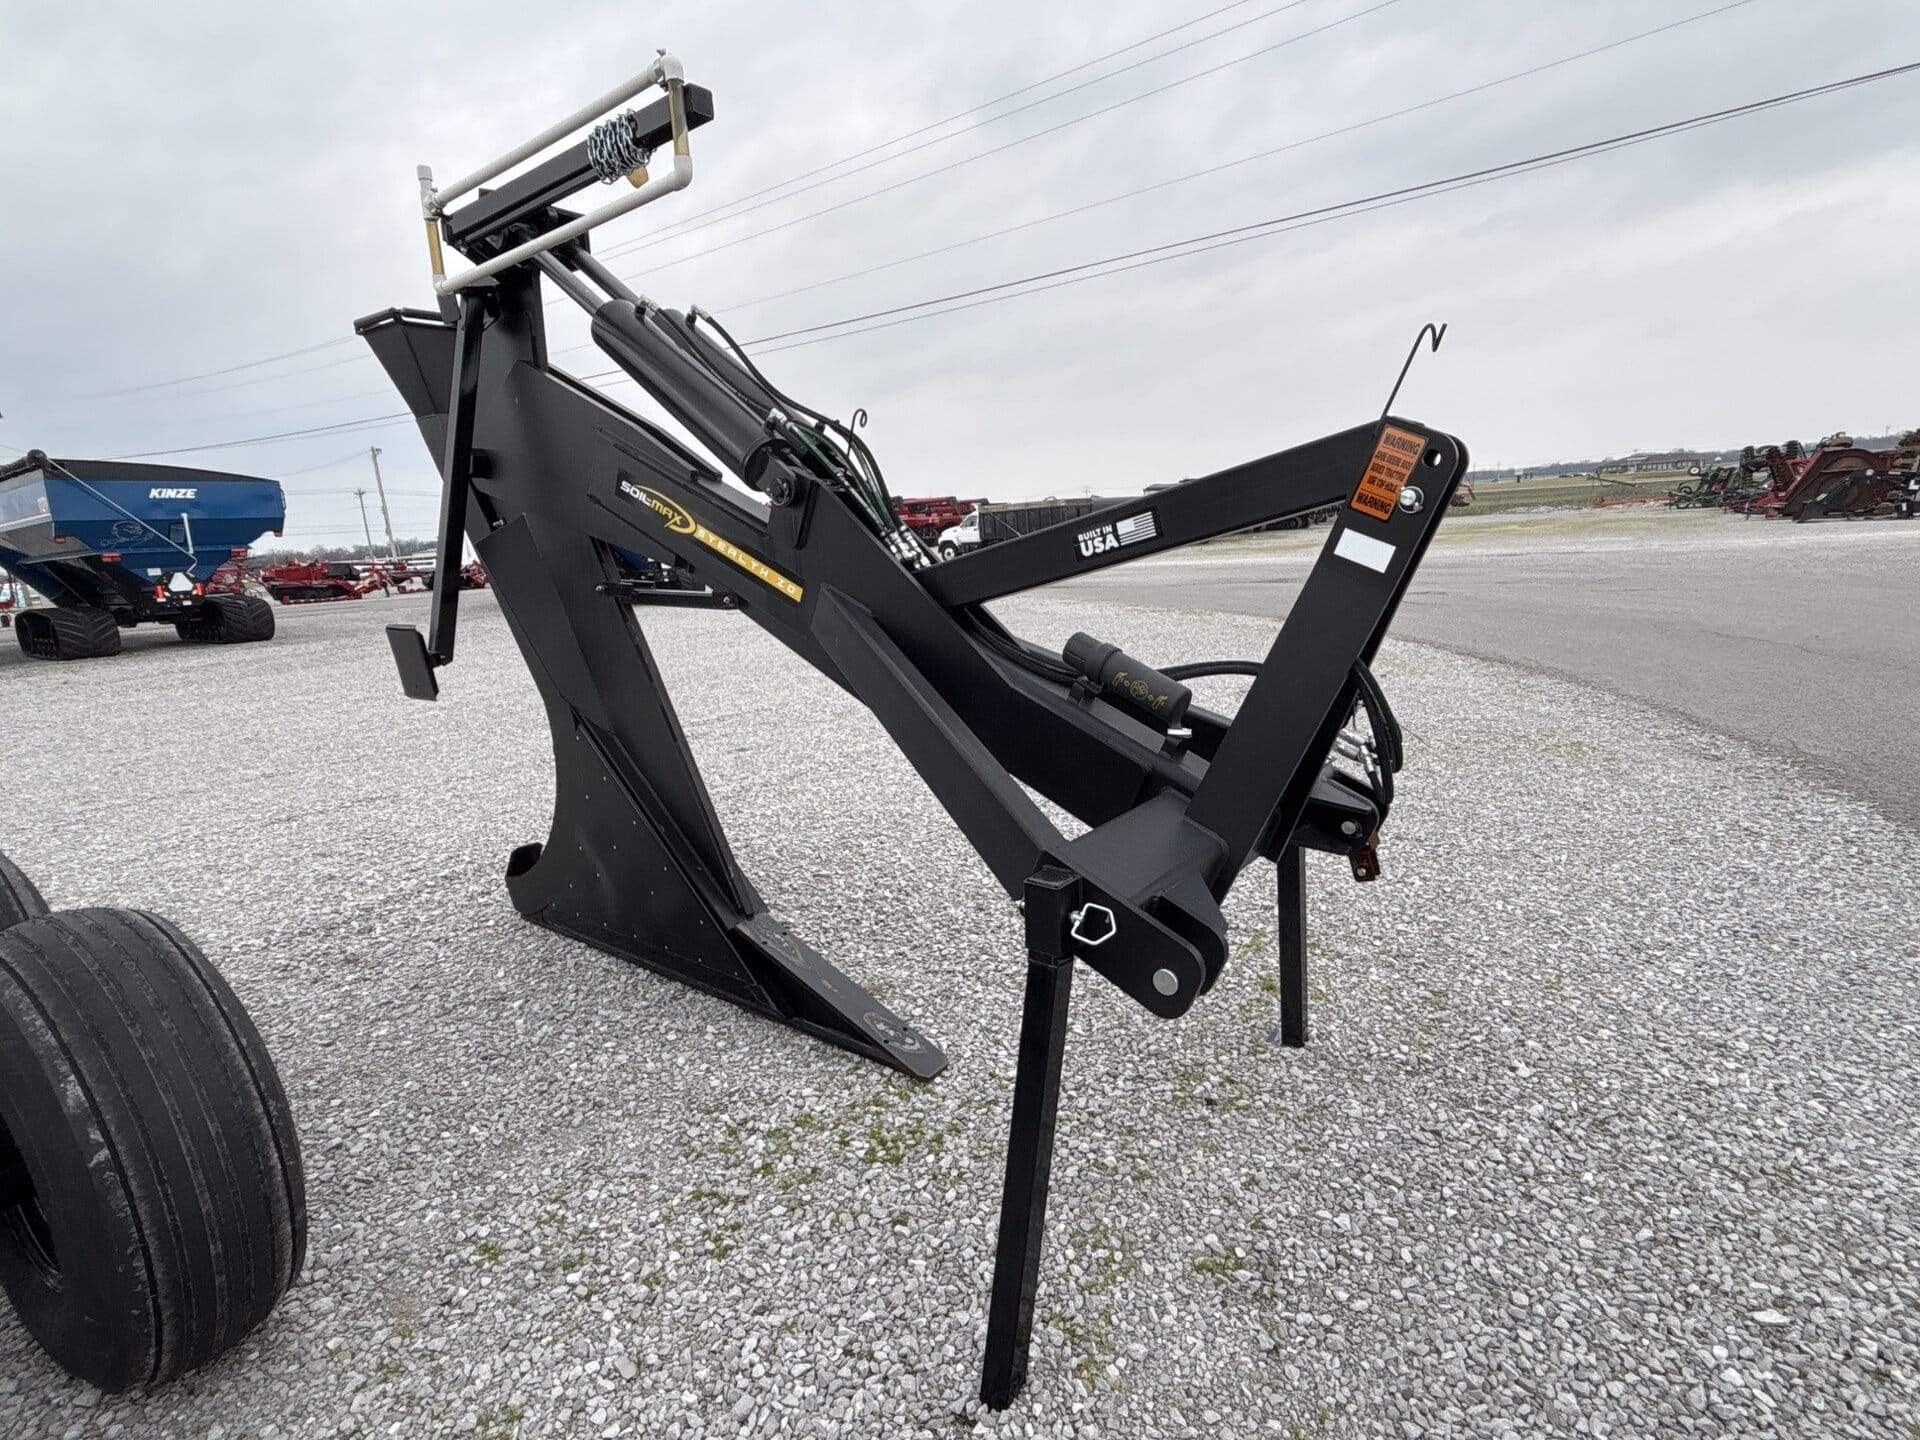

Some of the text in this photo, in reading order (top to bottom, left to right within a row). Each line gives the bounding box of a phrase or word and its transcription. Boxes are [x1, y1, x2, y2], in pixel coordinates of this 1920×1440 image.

[1383, 432, 1421, 455] WARNING
[149, 488, 197, 498] KINZE
[620, 480, 683, 527] SOIL-MAX
[1355, 491, 1392, 514] WARNING
[1077, 524, 1113, 541] BUILT IN
[698, 528, 769, 577] STEALTH
[1080, 533, 1120, 557] USA
